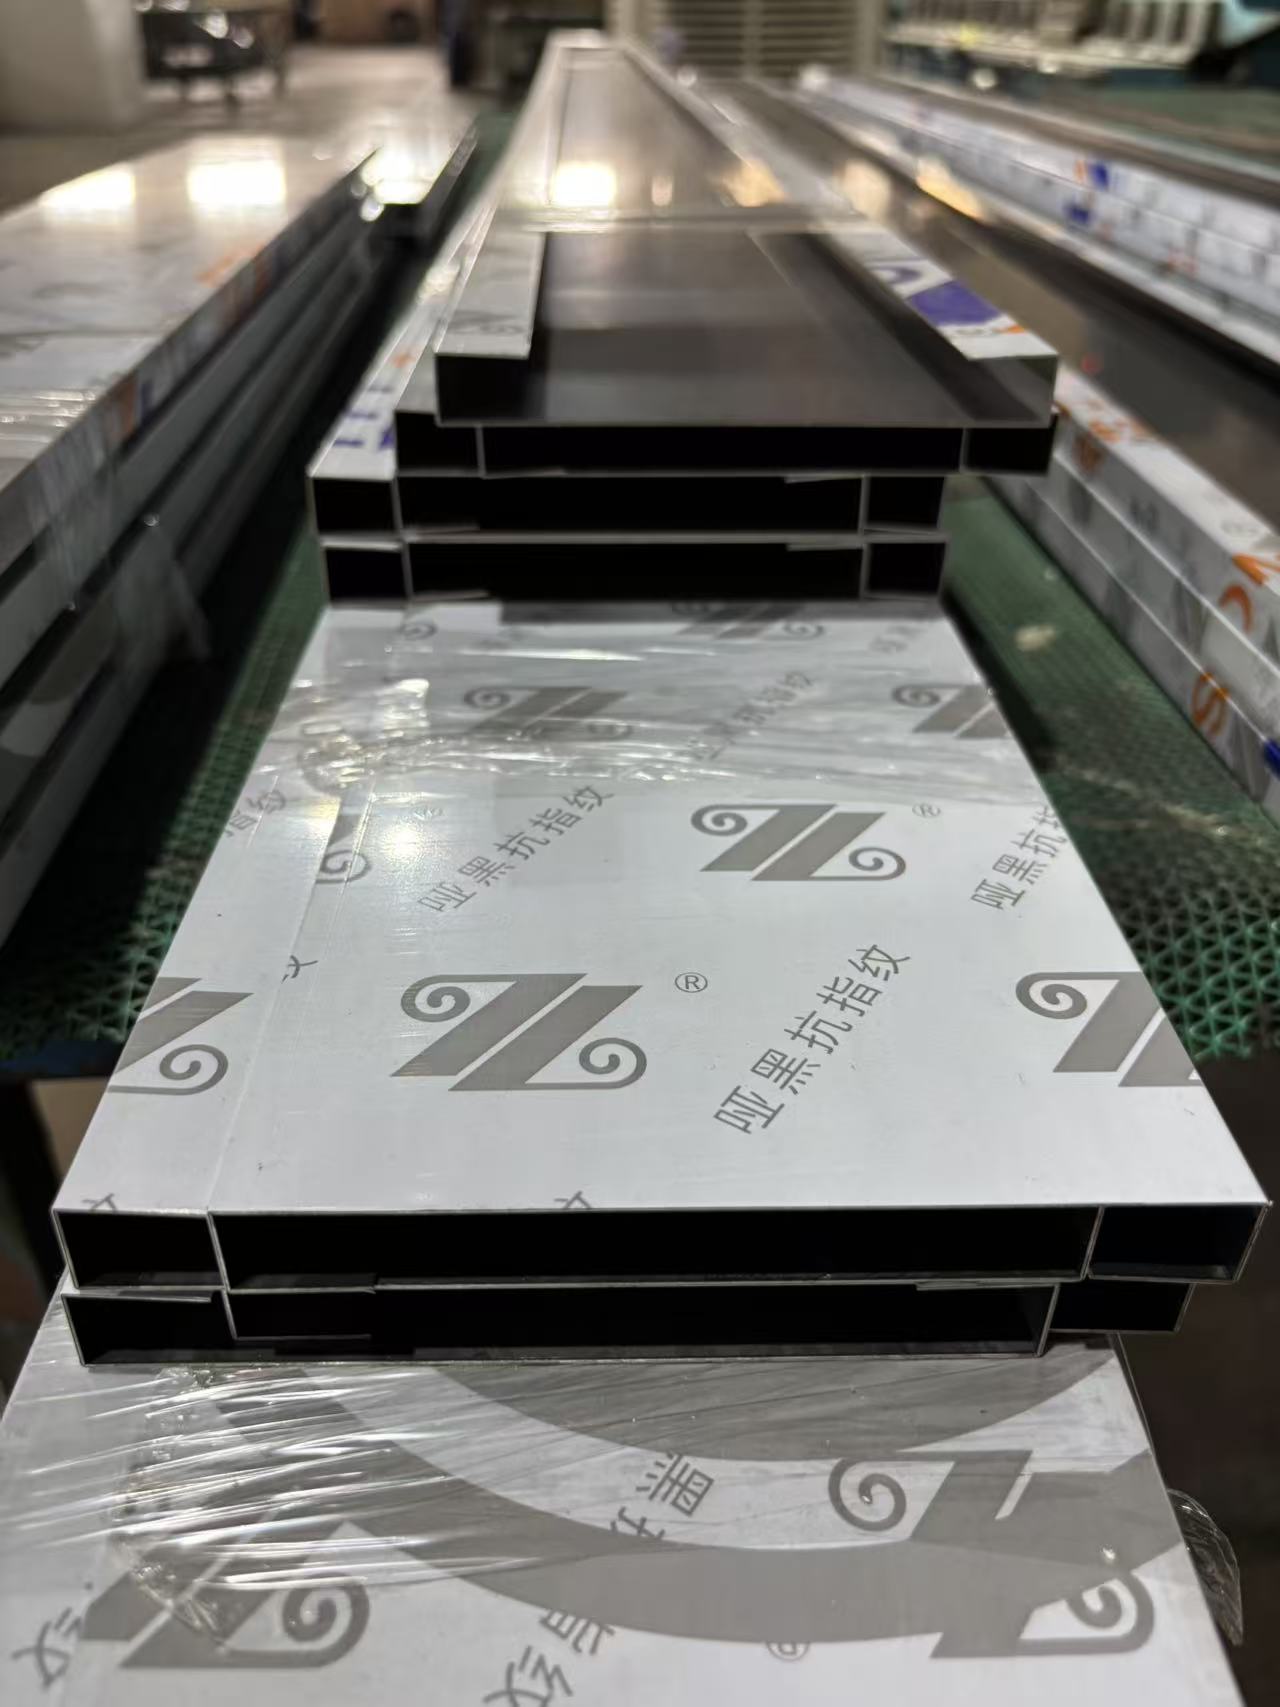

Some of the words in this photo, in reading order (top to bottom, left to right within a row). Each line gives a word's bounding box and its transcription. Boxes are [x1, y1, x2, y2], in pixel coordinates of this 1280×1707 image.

[417, 784, 614, 913] 哑黑抗指纹
[713, 944, 911, 1135] 哑黑抗指纹
